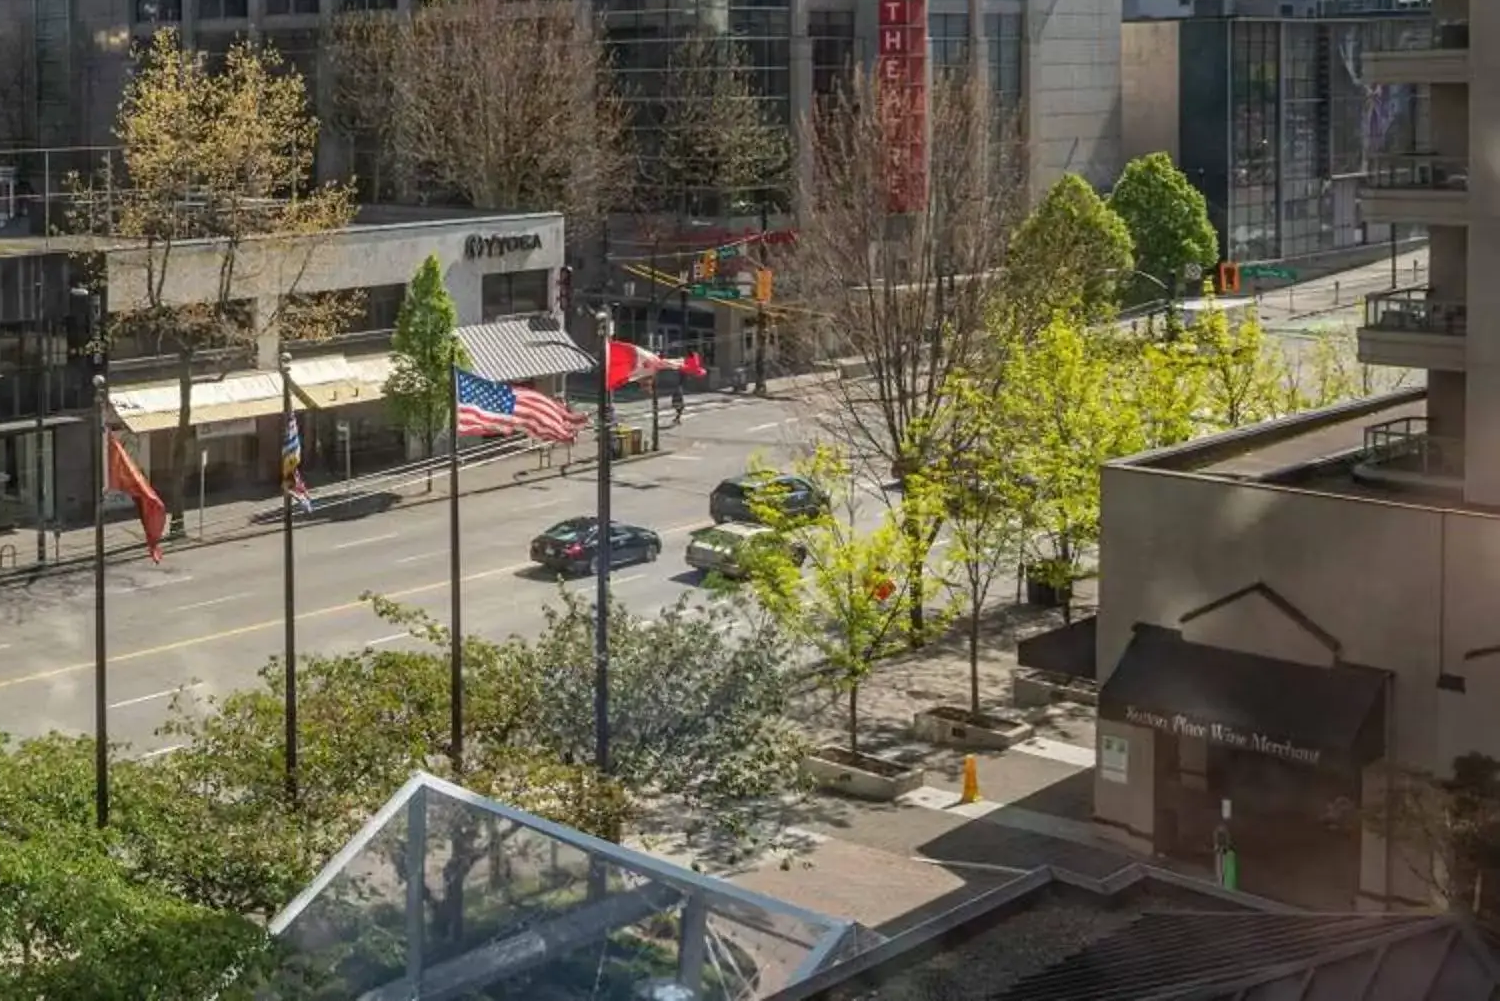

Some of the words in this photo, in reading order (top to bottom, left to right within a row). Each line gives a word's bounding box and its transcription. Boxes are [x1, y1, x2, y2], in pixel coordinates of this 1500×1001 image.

[884, 1, 902, 194] THEATRE
[1172, 712, 1207, 738] Place
[1211, 722, 1246, 745] Wine
[1251, 732, 1320, 764] Merchant
